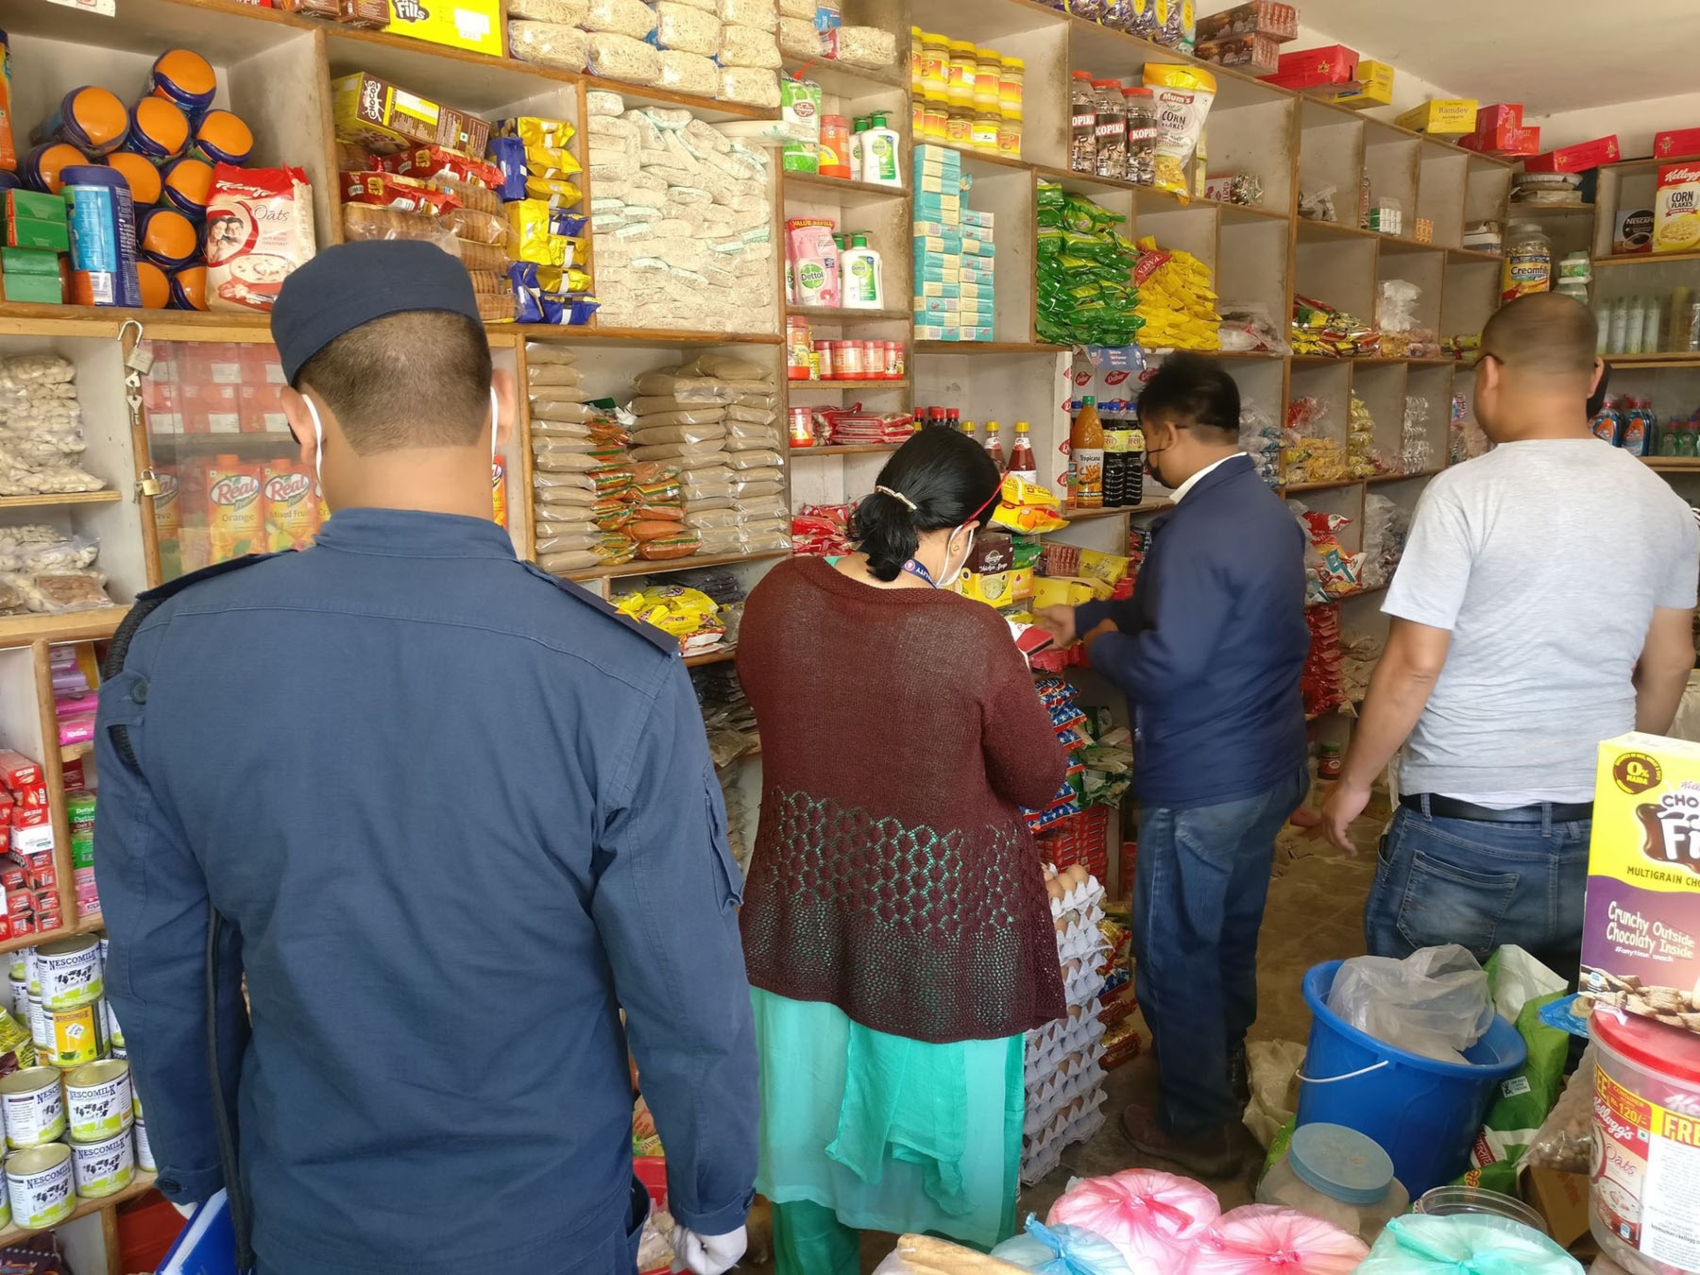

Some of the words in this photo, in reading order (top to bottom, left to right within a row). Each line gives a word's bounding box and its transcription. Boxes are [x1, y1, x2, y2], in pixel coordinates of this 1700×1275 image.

[400, 2, 426, 20] Fills
[368, 81, 377, 119] CHOCOS
[1163, 92, 1192, 104] Mum's
[1072, 114, 1095, 126] OPIKO
[1162, 111, 1186, 124] CORN
[1096, 124, 1125, 136] KOPIKO
[1671, 190, 1694, 203] CORN
[801, 271, 824, 282] Dettol
[217, 479, 255, 499] Real
[270, 478, 305, 500] Real
[221, 513, 254, 523] Orange
[1626, 761, 1650, 778] 0%
[38, 788, 46, 805] RED
[1662, 794, 1700, 809] CHO
[1627, 866, 1683, 885] MULTIGRAIN
[1685, 876, 1700, 888] CHO
[1608, 900, 1650, 936] Crunchy
[1652, 921, 1695, 949] Outside
[1606, 921, 1656, 955] Chocolaty
[1659, 939, 1694, 959] Inside
[49, 950, 97, 971] NESCOMILK
[36, 1085, 60, 1105] NESCO
[69, 1083, 116, 1100] NESCOMILK
[1663, 1111, 1700, 1148] FRE
[78, 1137, 126, 1160] NESCOMILK
